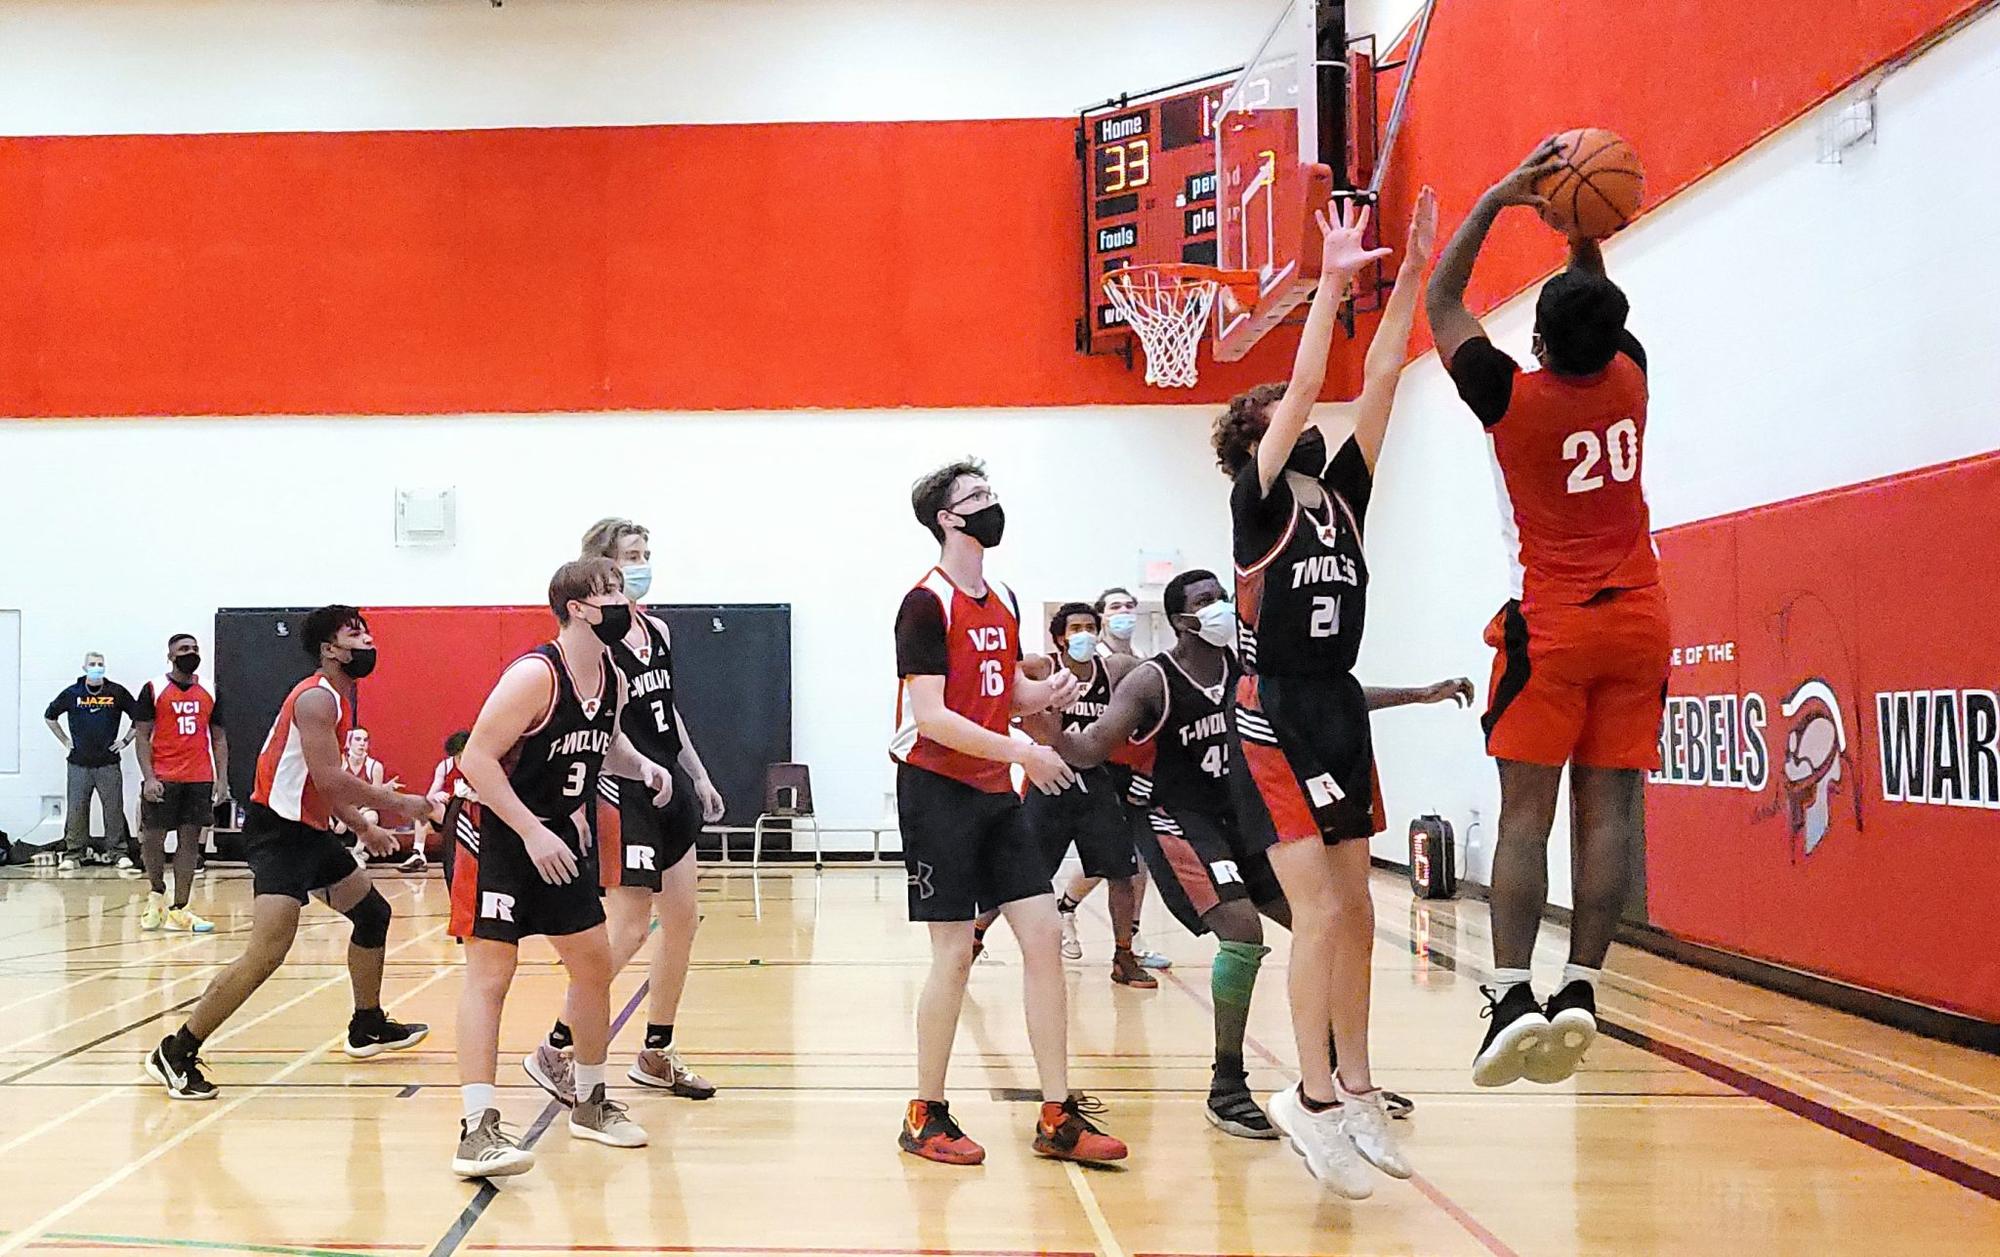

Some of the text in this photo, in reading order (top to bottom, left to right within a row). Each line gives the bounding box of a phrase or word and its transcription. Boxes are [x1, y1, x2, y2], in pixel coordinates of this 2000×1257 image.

[1102, 116, 1143, 142] Home
[1105, 140, 1150, 192] 33
[1100, 227, 1134, 250] fouls
[1562, 418, 1638, 494] 20
[967, 626, 1008, 652] VCI
[1685, 645, 1704, 664] OF
[1706, 642, 1734, 662] THE
[979, 659, 1005, 697] 16
[82, 696, 114, 705] JAZZ
[171, 701, 200, 714] VCI
[177, 716, 196, 735] 15
[650, 700, 670, 733] 2
[562, 762, 587, 796] 3
[480, 891, 515, 922] R
